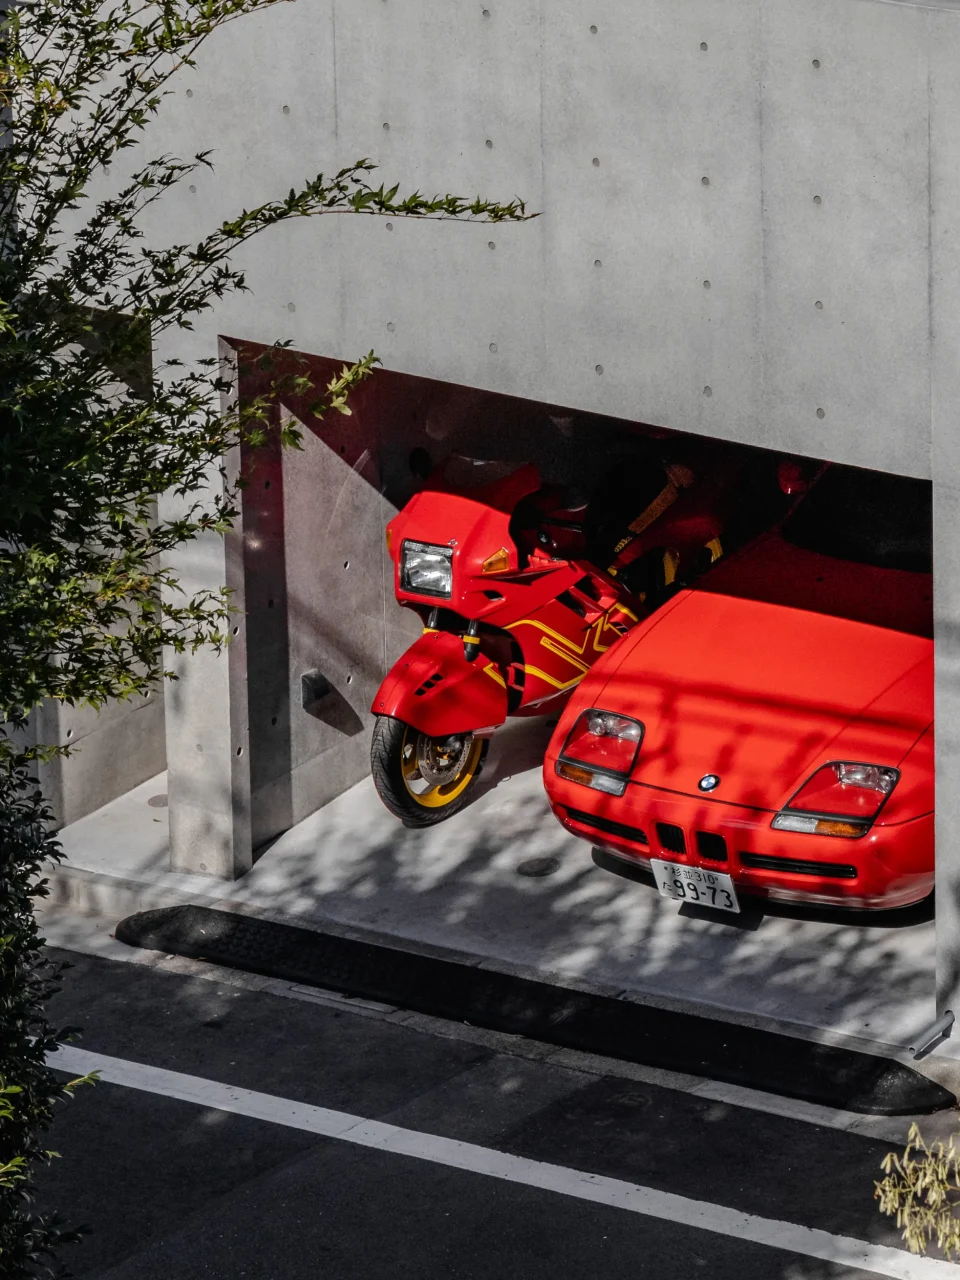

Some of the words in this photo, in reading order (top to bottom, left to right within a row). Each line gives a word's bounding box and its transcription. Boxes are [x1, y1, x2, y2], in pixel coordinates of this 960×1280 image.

[695, 871, 715, 885] 310
[663, 881, 672, 891] た
[673, 879, 733, 908] 99-73
